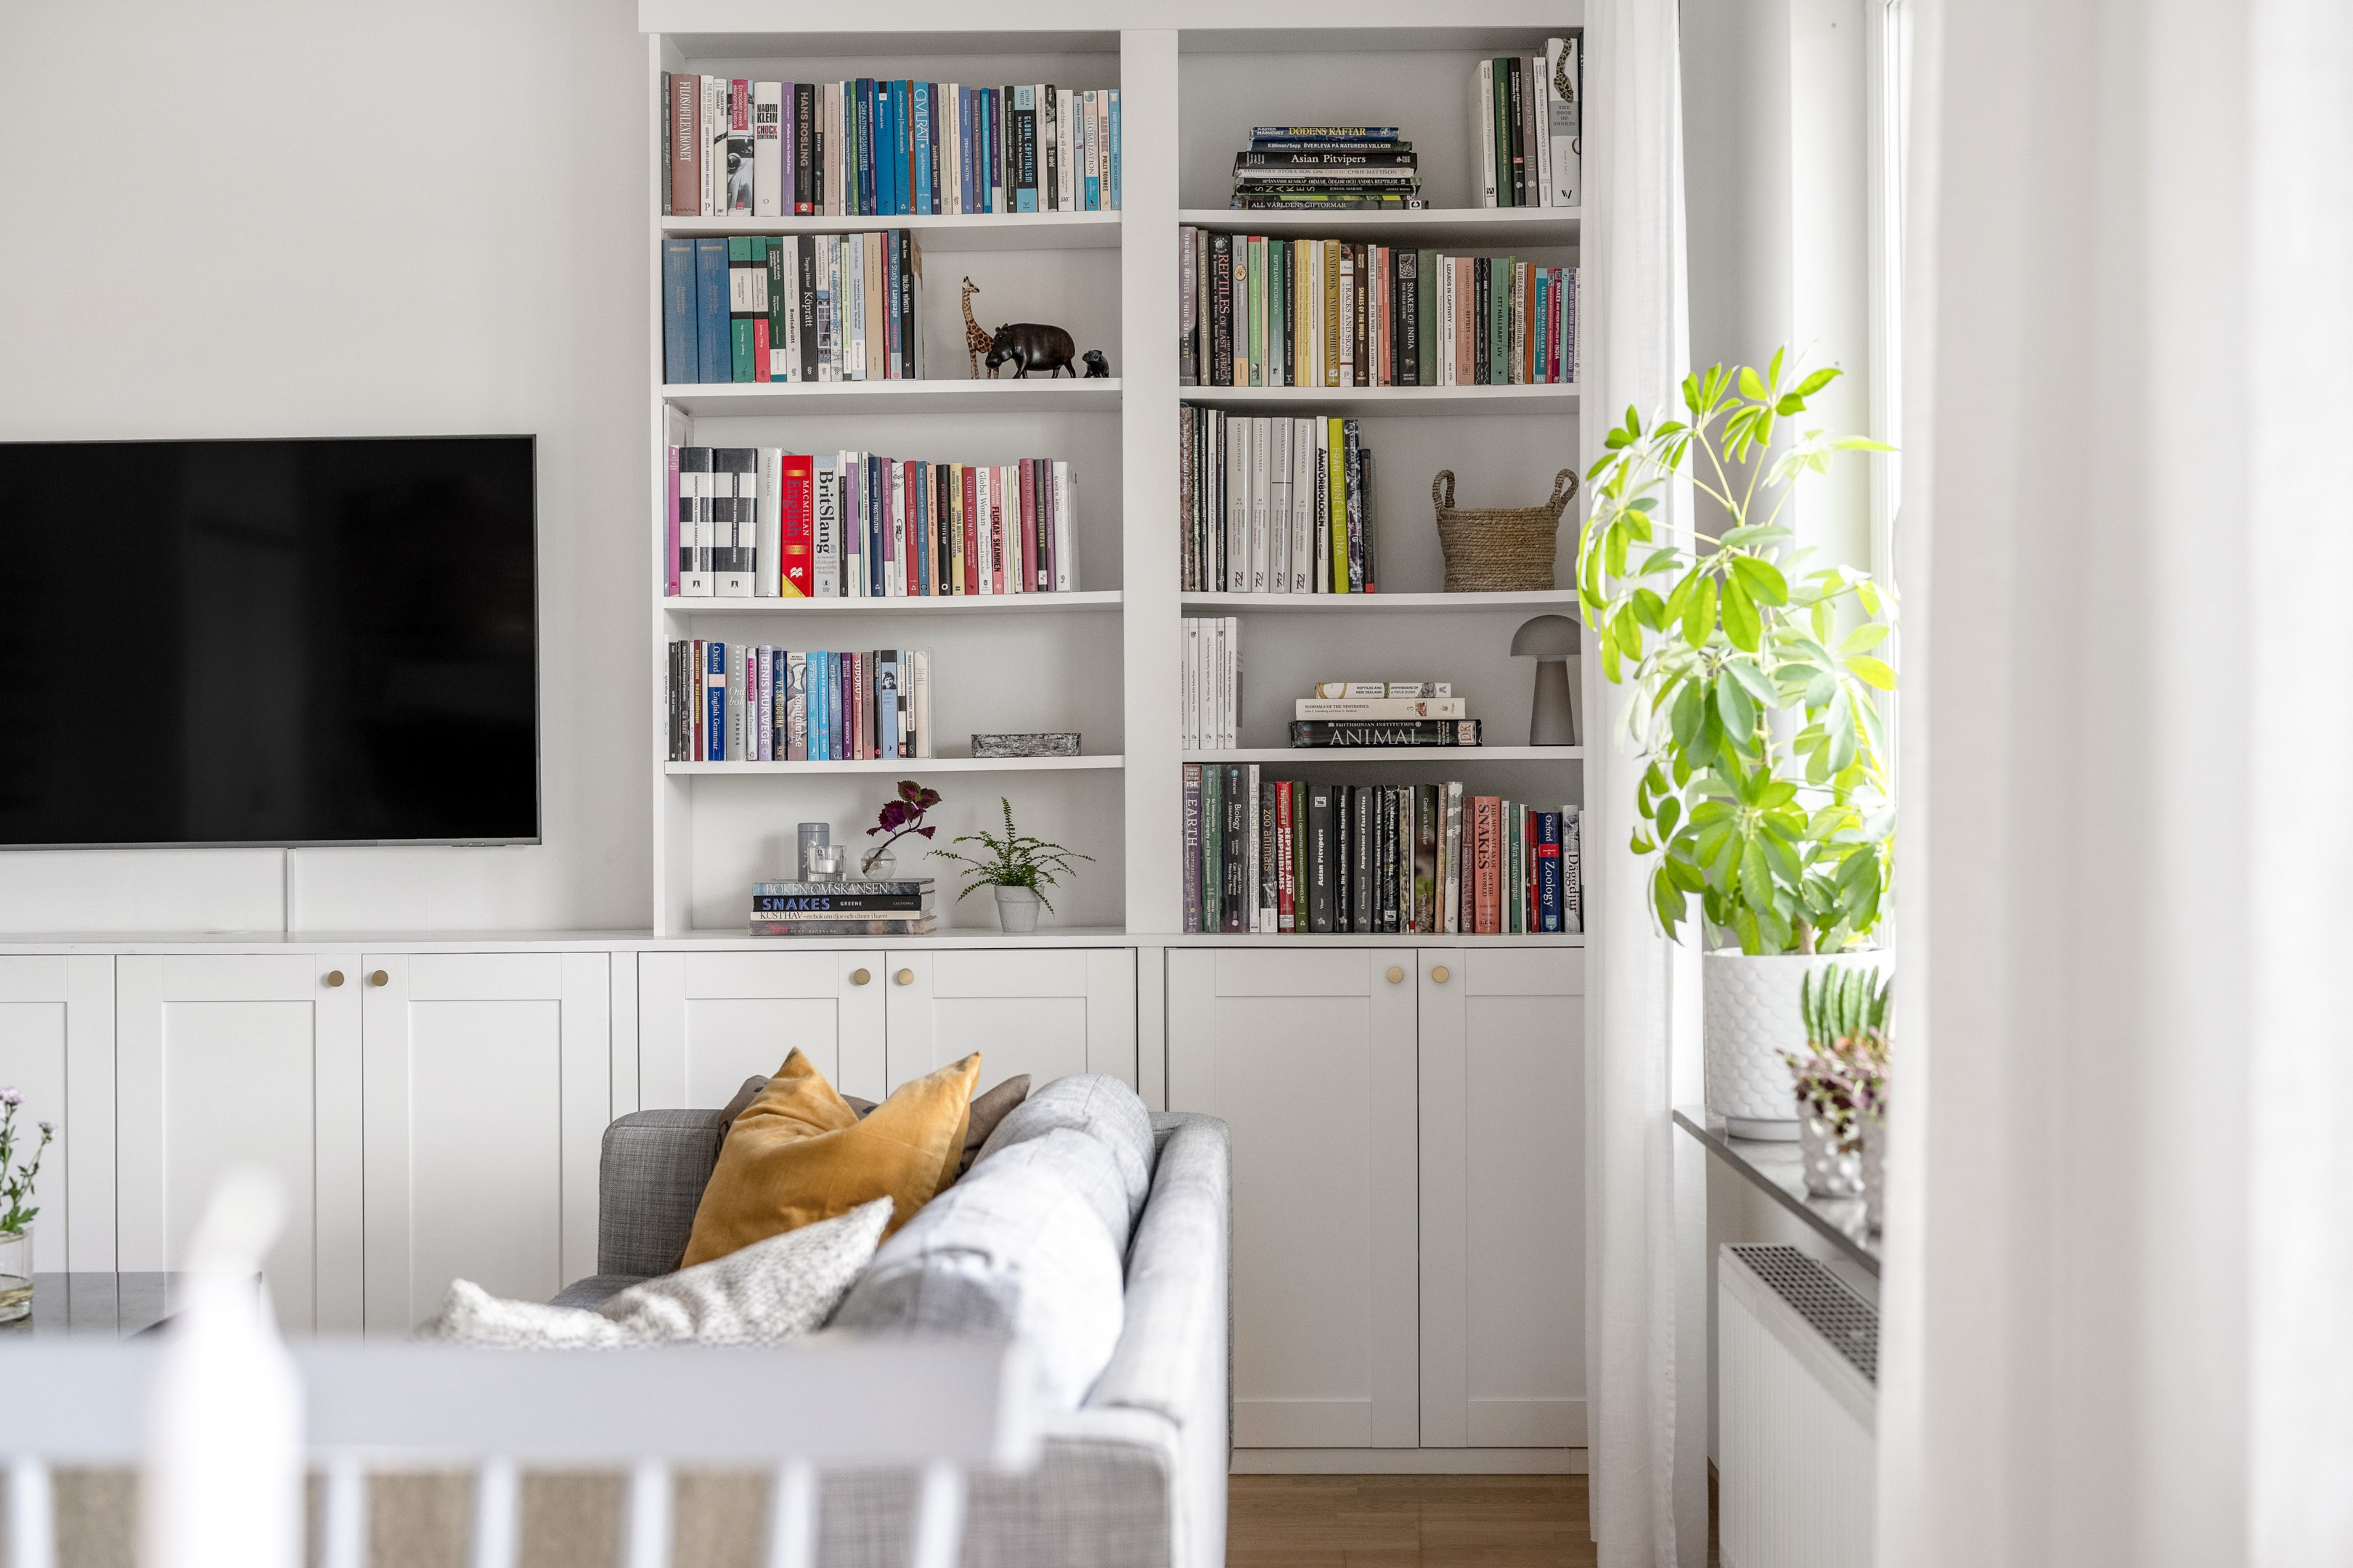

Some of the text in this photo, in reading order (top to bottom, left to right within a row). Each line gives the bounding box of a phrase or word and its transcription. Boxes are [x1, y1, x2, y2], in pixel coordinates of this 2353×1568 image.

[680, 81, 690, 161] FILOSOFILEXIKONET
[757, 104, 778, 113] NAOMI
[757, 113, 778, 123] KLEIN
[915, 89, 929, 144] CIVILRÄTT
[757, 126, 778, 134] CHOCK
[1289, 127, 1366, 136] DÖDENS KÄFTAR
[1323, 154, 1366, 165] Pitvipers
[1218, 254, 1230, 314] REPTILES
[802, 291, 813, 327] Köprätt
[1220, 316, 1226, 327] OF
[1407, 315, 1414, 324] OF
[783, 480, 802, 536] English
[816, 470, 835, 554] BritSlang
[1332, 447, 1345, 555] FRÅN LINNÉ TILL DNA
[761, 656, 770, 745] DENIS MUKWEGE
[794, 693, 804, 747] kapitalet.se
[1329, 729, 1420, 745] ANIMAL
[1188, 799, 1197, 846] EARTH
[1478, 804, 1490, 870] SNAKES
[1263, 830, 1273, 871] animals
[1491, 859, 1496, 869] OF
[765, 883, 888, 894] BOKEN OM SKANSEN
[1543, 861, 1555, 907] Zoology
[1566, 854, 1578, 912] Däggdjur
[763, 898, 831, 910] SNAKES
